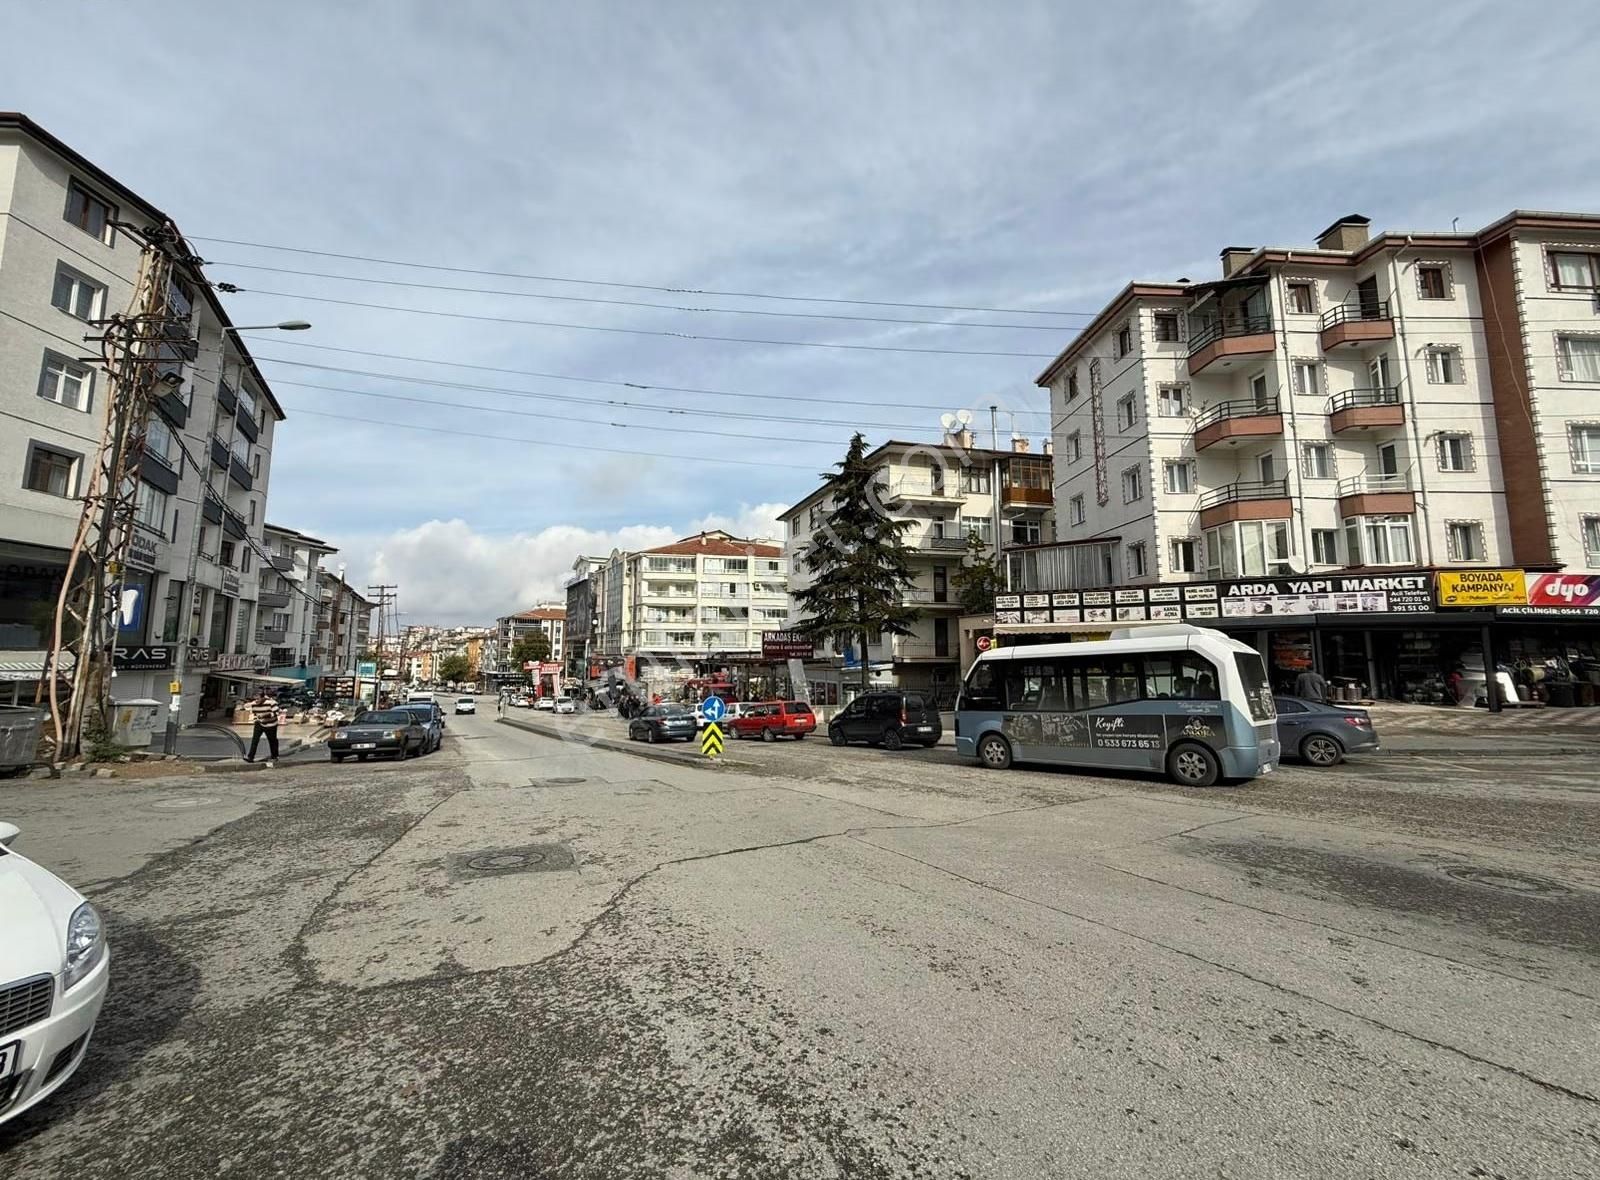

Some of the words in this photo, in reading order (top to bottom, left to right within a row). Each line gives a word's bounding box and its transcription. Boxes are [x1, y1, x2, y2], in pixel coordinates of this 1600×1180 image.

[1459, 573, 1504, 582] BOYADA
[1228, 583, 1280, 596] ARDA
[1287, 580, 1332, 593] YAPI
[1341, 577, 1426, 592] MARKET
[1451, 583, 1514, 593] KAMPANYA!
[1545, 577, 1589, 602] dyo
[1502, 606, 1521, 614] ACİL
[764, 632, 792, 643] ARKADAŞ
[113, 648, 167, 660] RAS
[1095, 717, 1125, 731] Keyifli
[1097, 738, 1104, 747] 0
[1104, 739, 1120, 747] 533
[1121, 739, 1137, 748] 673
[1138, 740, 1150, 749] 65
